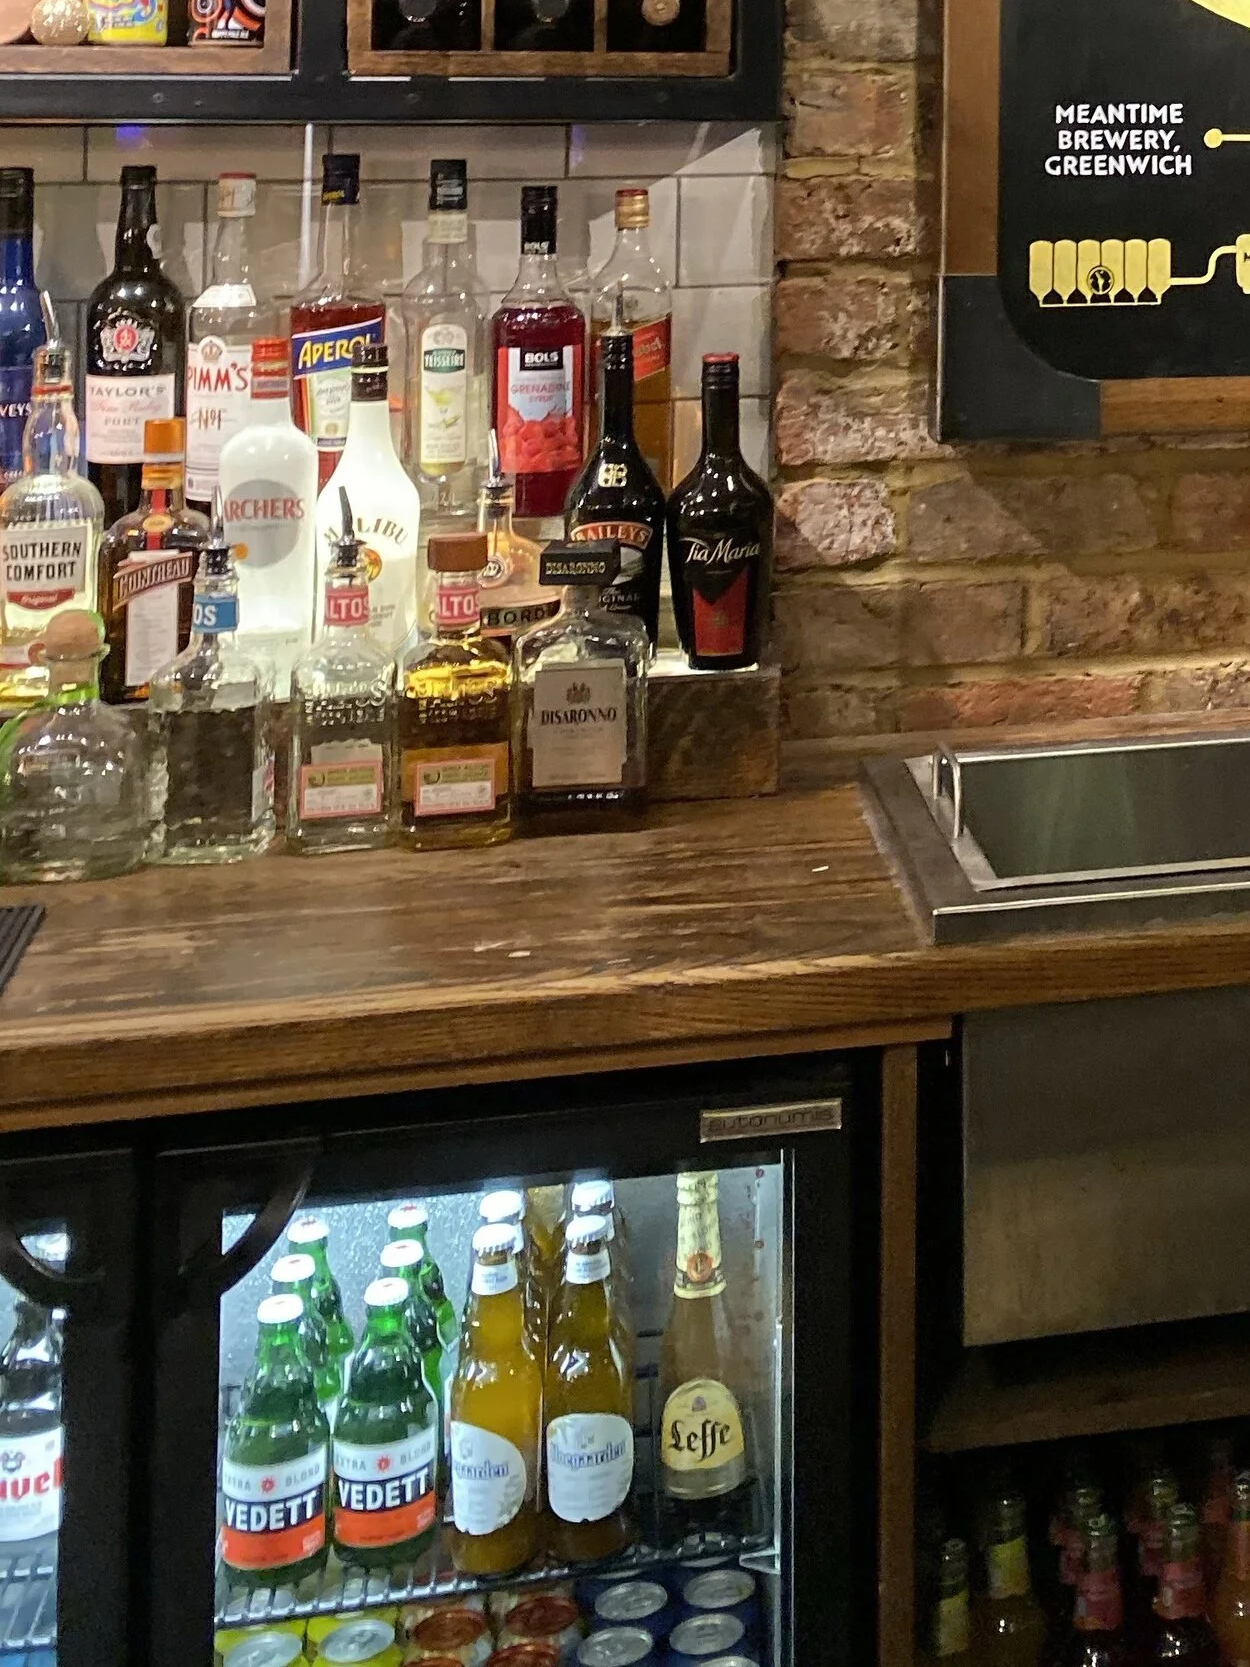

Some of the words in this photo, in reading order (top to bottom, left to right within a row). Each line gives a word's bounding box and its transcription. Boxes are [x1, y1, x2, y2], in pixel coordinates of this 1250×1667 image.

[1055, 103, 1184, 125] MEANTIME
[1058, 129, 1181, 153] BREWERY,
[1044, 154, 1193, 176] GREENWICH
[524, 350, 559, 363] BOLS
[187, 363, 249, 393] PIMM'S
[2, 541, 82, 562] SOUTHERN
[679, 537, 711, 563] Tia
[705, 538, 761, 566] Maria
[6, 562, 76, 582] COMFORT
[119, 557, 190, 600] COINTREAU
[545, 562, 606, 574] DISARONNO
[541, 707, 618, 726] DISARONNO
[669, 1419, 731, 1463] Leffe
[338, 1467, 429, 1511] VEDETT
[225, 1490, 317, 1532] VEDETT
